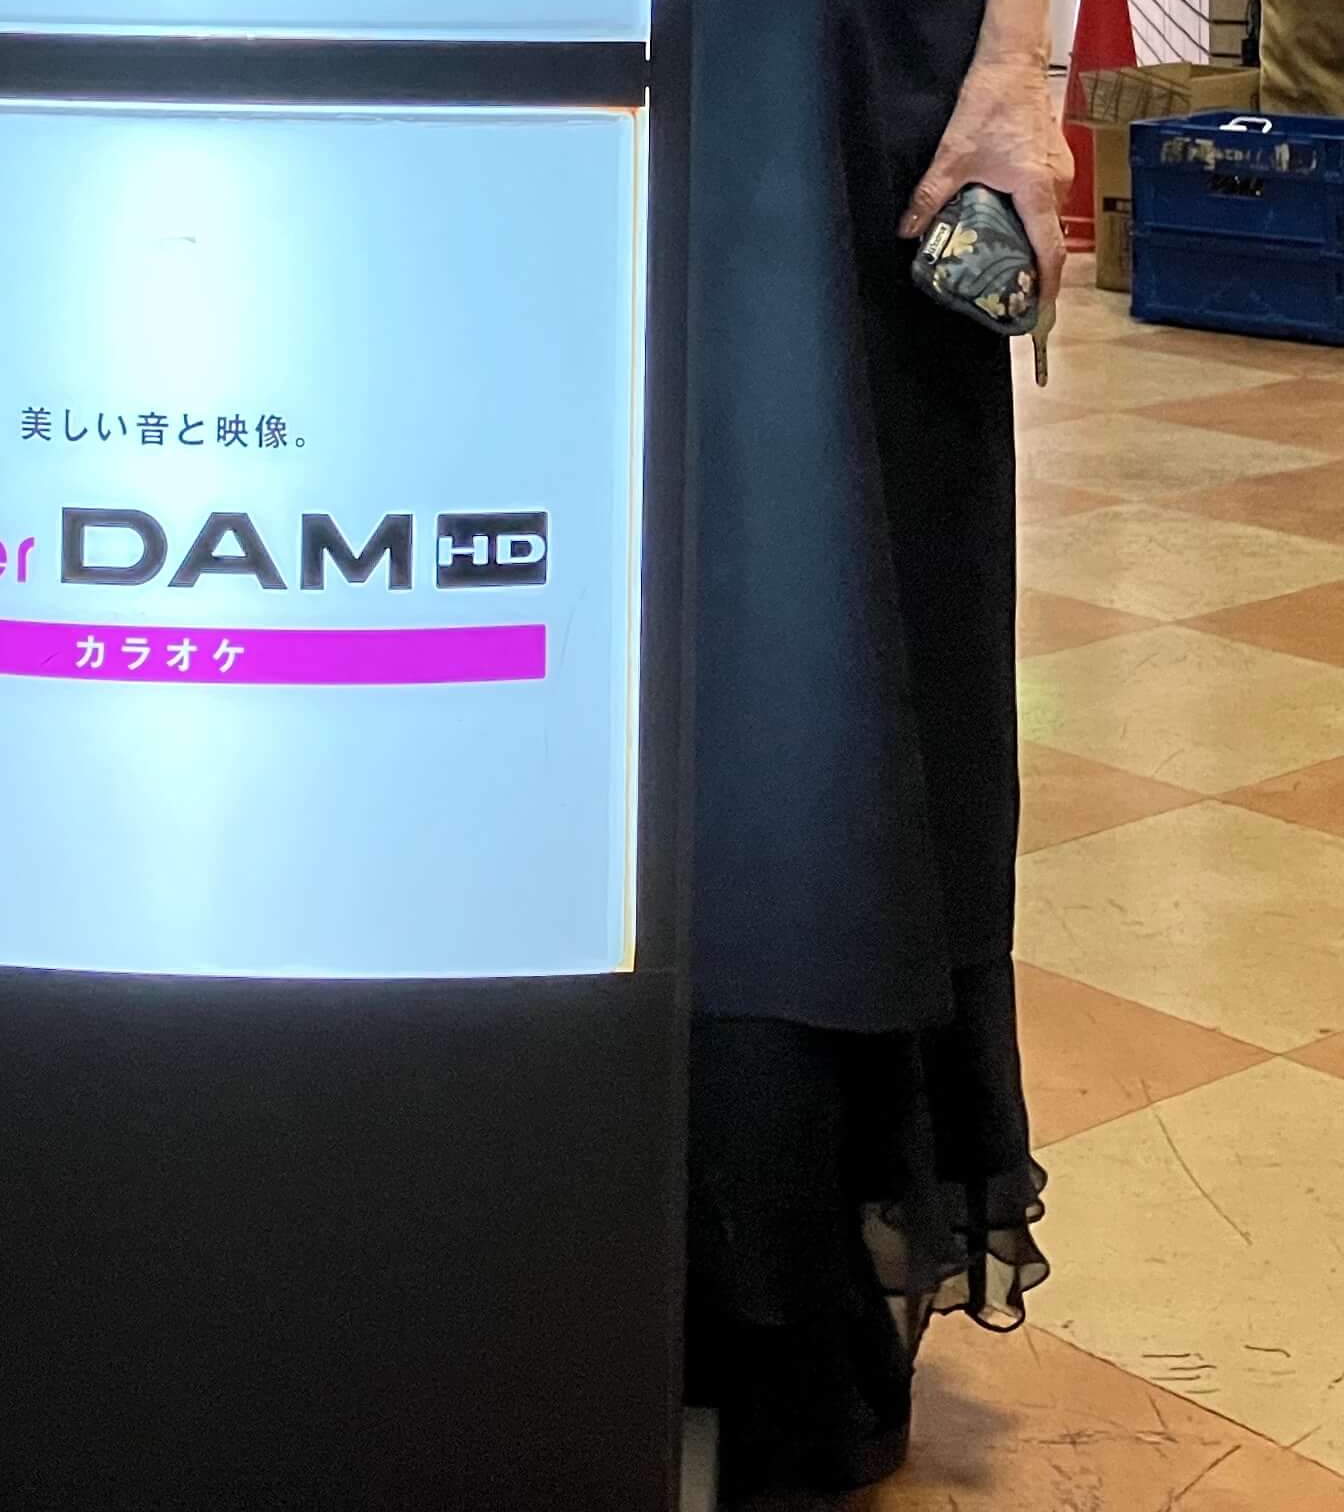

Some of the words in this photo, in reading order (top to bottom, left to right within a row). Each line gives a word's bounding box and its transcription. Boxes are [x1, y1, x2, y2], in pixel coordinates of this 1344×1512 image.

[20, 406, 309, 449] 美しい音と映像。
[60, 506, 413, 590] DAM
[74, 634, 248, 673] カラオケ
